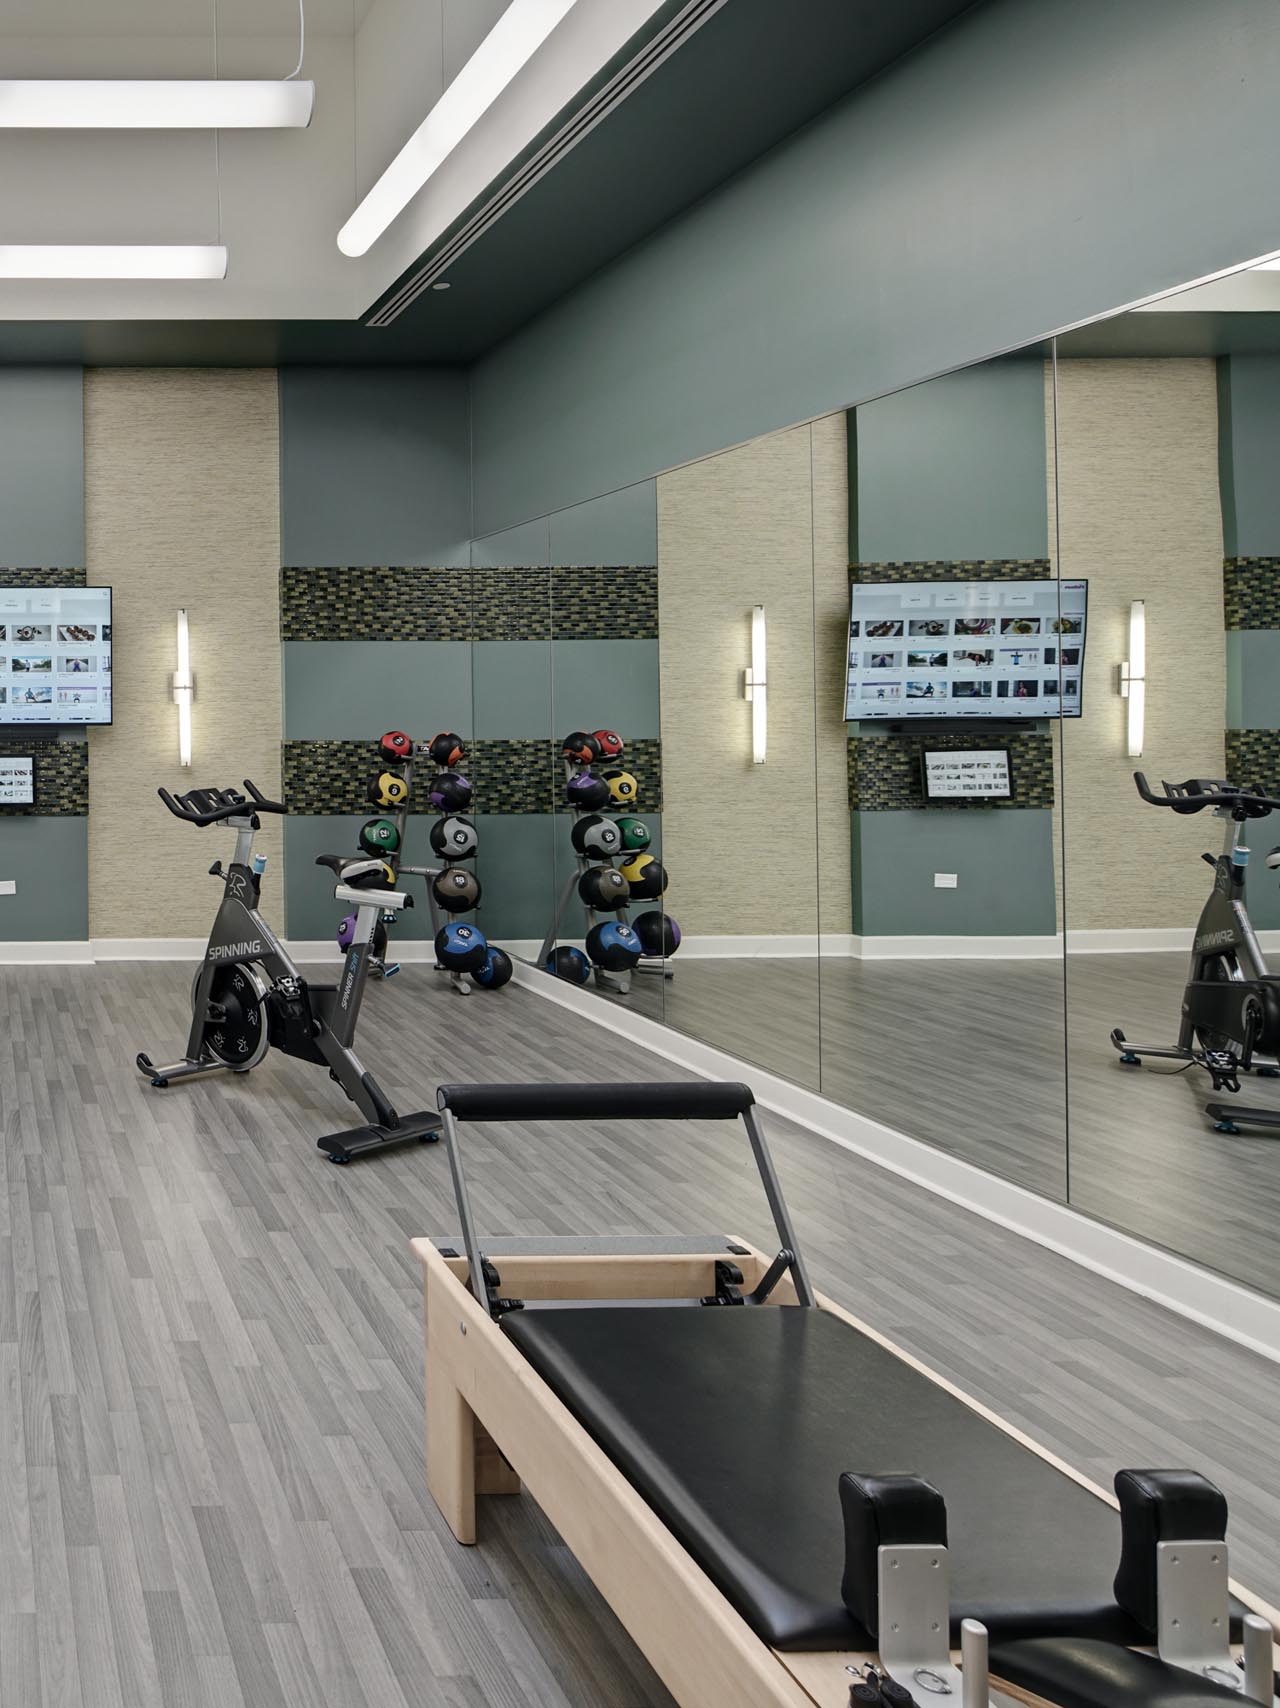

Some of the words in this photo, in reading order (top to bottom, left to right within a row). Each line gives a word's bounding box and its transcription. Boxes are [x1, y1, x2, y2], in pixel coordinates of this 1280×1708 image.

[455, 875, 465, 883] 18
[209, 940, 261, 960] SPINNING
[341, 972, 354, 1010] SPINNER
